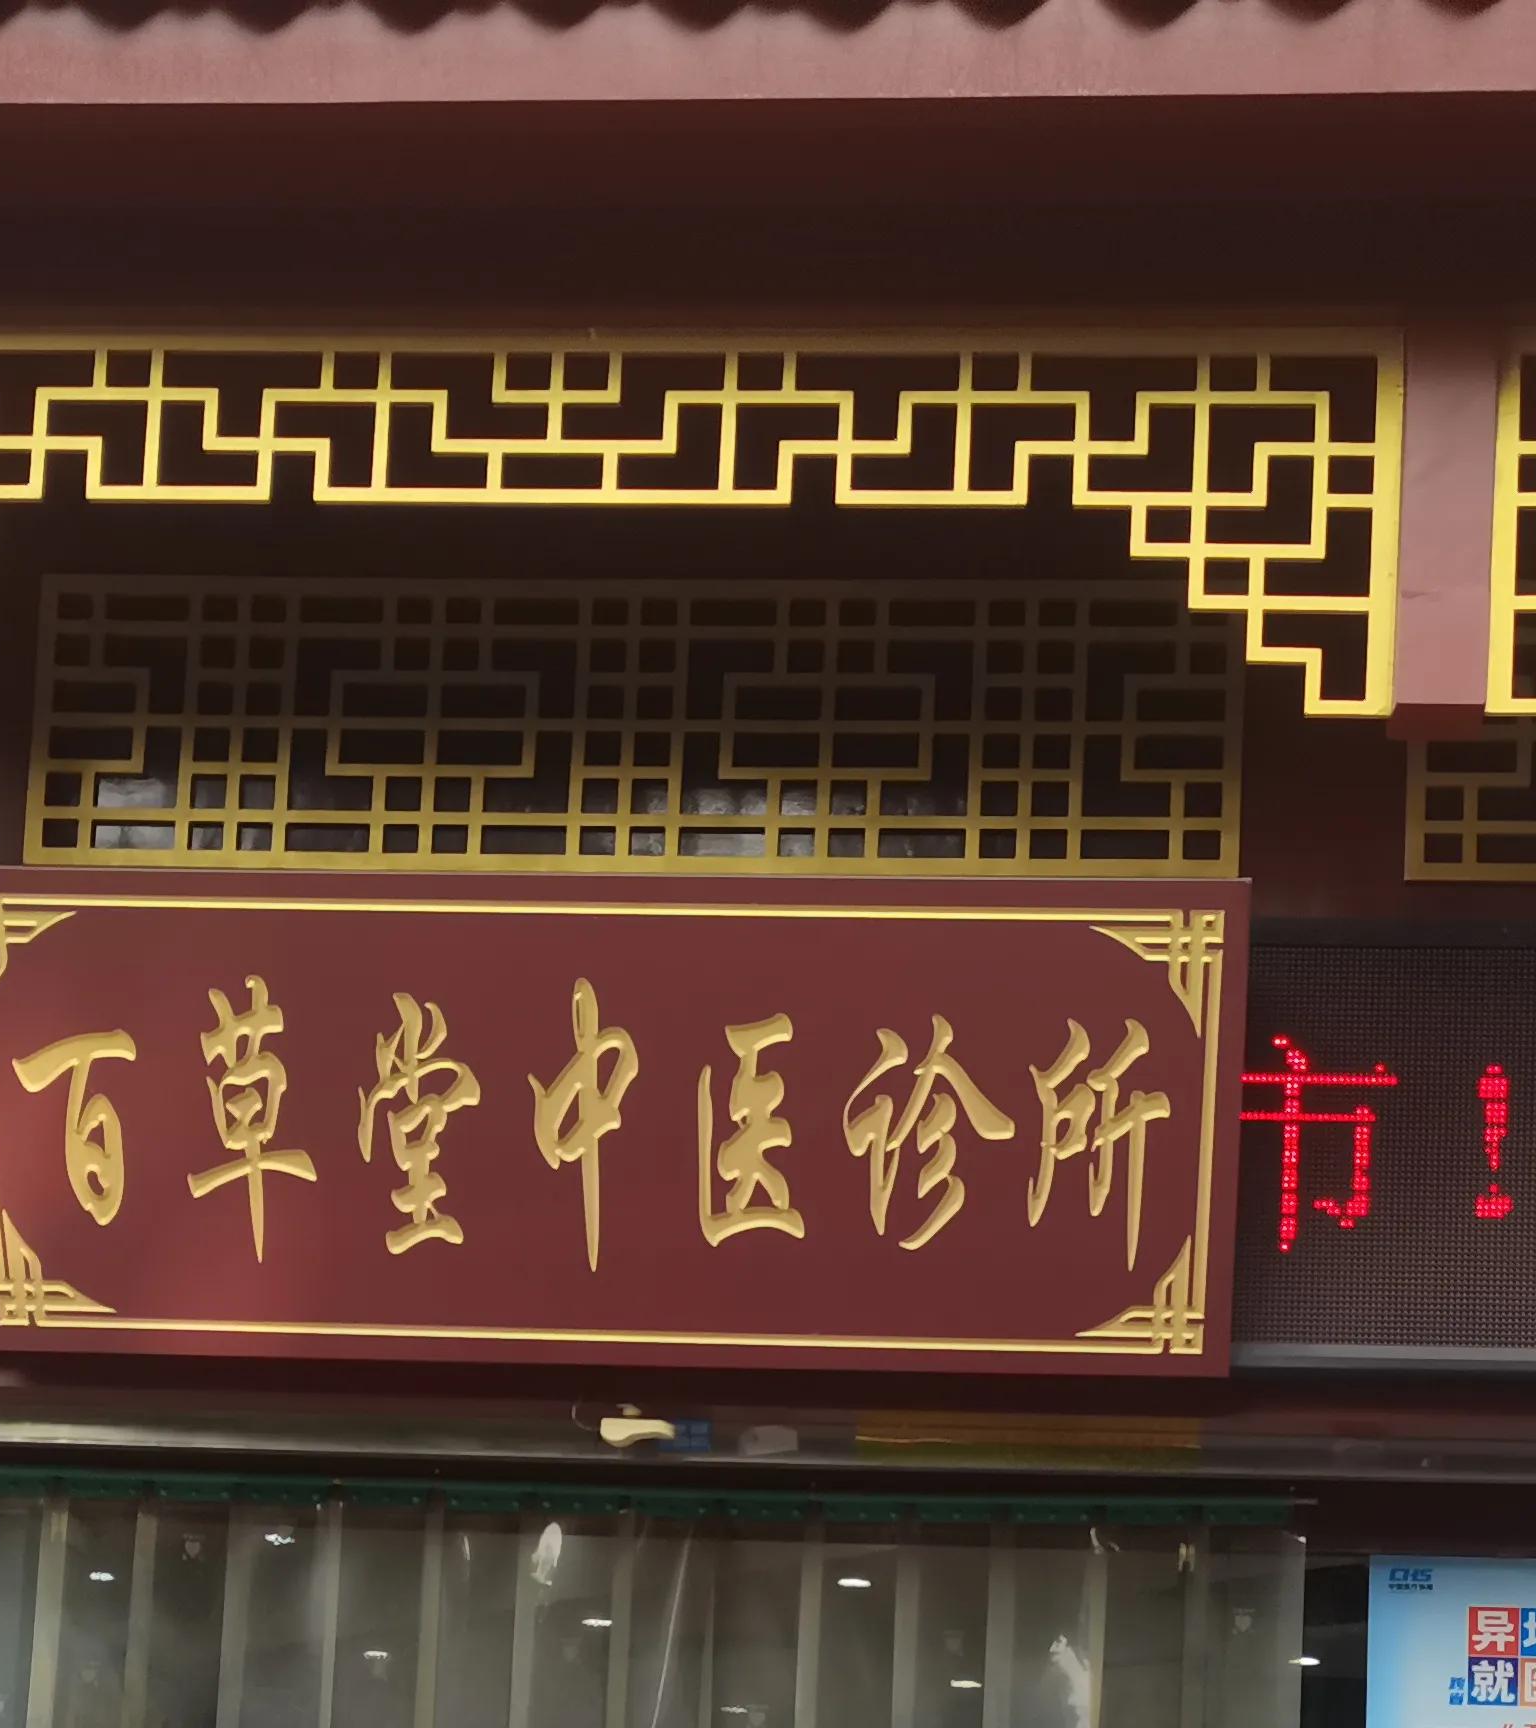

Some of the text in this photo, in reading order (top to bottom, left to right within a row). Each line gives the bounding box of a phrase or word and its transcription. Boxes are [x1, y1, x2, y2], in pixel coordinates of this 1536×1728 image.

[11, 975, 1171, 1272] 百草堂中医诊所
